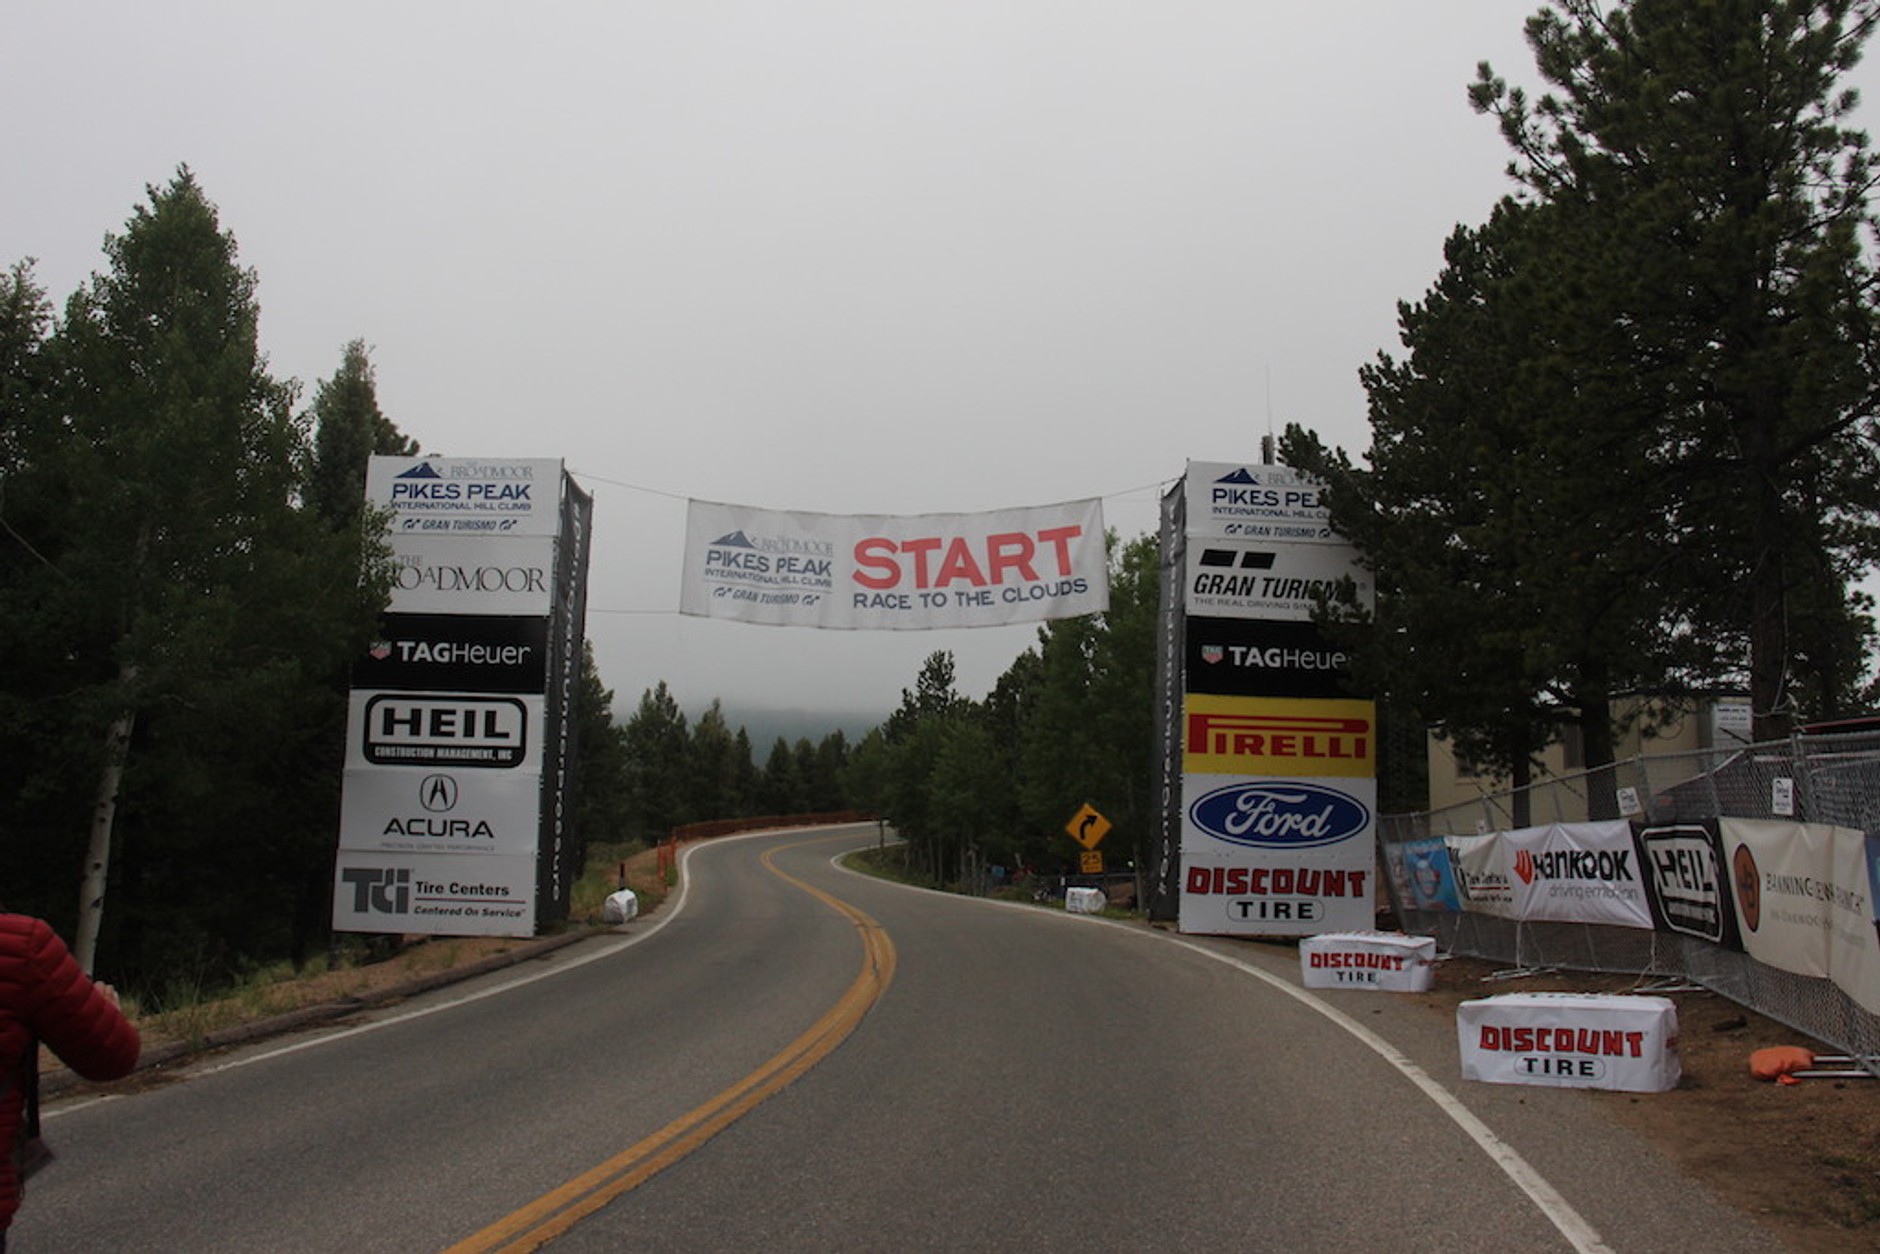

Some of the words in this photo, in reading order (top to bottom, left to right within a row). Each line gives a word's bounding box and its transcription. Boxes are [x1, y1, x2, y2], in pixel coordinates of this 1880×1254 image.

[392, 483, 461, 499] PIKES
[467, 484, 531, 500] PEAK
[1213, 488, 1279, 506] PIKES
[392, 501, 471, 510] INTERNATIONAL
[474, 502, 496, 511] HILL
[498, 502, 531, 511] CLIMB
[1212, 506, 1291, 517] INTERNATIONAL
[1293, 510, 1314, 519] HILL
[422, 520, 449, 530] GRAN
[452, 520, 496, 531] TURISMO
[1244, 525, 1270, 536] GRAN
[1274, 527, 1315, 538] TURISMO
[706, 550, 770, 573] PIKES
[776, 557, 832, 577] PEAK
[852, 524, 1082, 590] START
[705, 568, 779, 584] INTERNATIONAL
[801, 577, 832, 588] CLIMB
[1193, 573, 1256, 597] GRAN
[732, 589, 758, 602] GRAN
[760, 593, 800, 605] TURISMO
[853, 593, 911, 609] RACE
[918, 592, 947, 608] TO
[955, 590, 995, 607] THE
[1002, 577, 1089, 603] CLOUDS
[1194, 597, 1215, 605] THE
[1217, 599, 1245, 608] REAL
[1247, 601, 1290, 610] DRIVING
[383, 707, 509, 738] HEIL
[1188, 714, 1369, 759] PIRELLI
[374, 747, 435, 757] CONSTRUCTION
[1225, 790, 1334, 837] Ford
[383, 818, 494, 838] ACURA
[1652, 849, 1713, 892] HEIL
[416, 882, 444, 893] Tire
[450, 882, 510, 896] Centers
[1186, 867, 1366, 898] DISCOUNT
[414, 906, 462, 916] Centered
[465, 907, 478, 916] On
[482, 907, 521, 917] Service
[1236, 901, 1314, 919] TIRE
[1310, 953, 1404, 970] DISCOUNT
[1337, 972, 1376, 983] TIRE
[1480, 1025, 1643, 1057] DISCOUNT
[1523, 1057, 1595, 1076] TIRE
